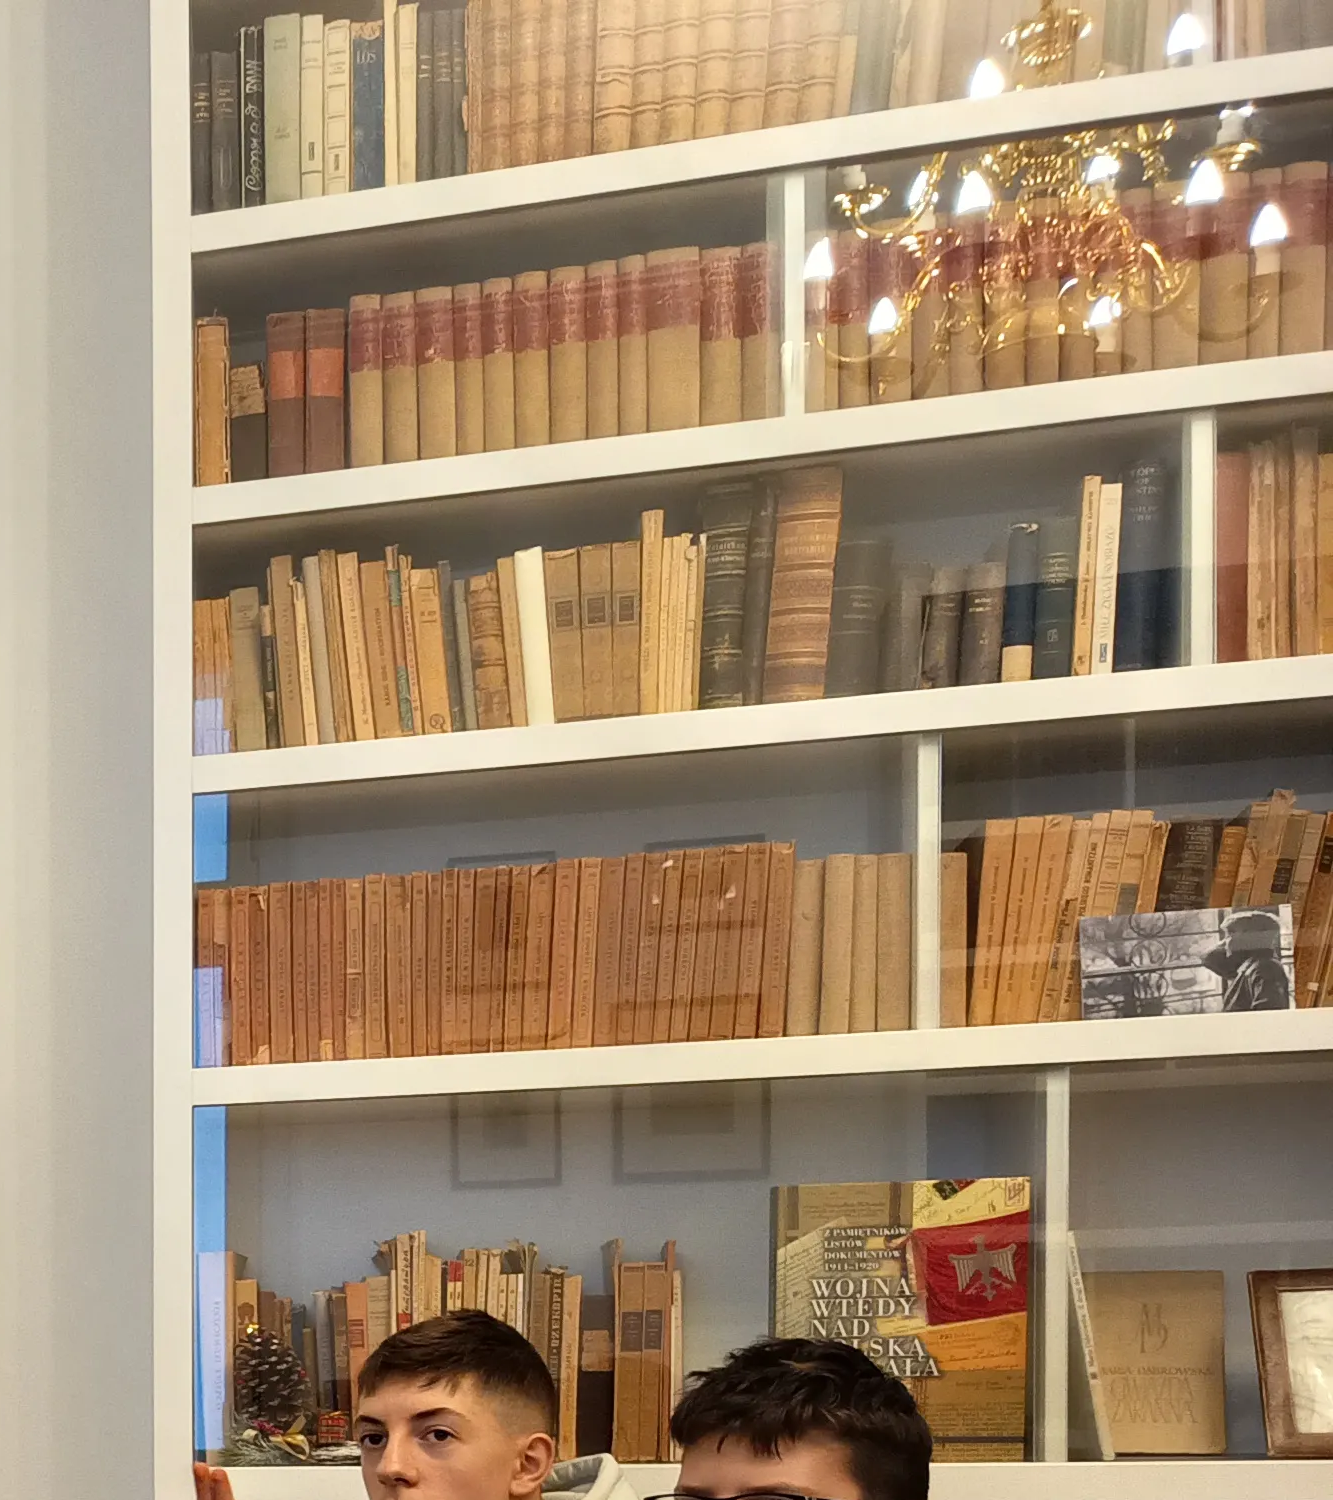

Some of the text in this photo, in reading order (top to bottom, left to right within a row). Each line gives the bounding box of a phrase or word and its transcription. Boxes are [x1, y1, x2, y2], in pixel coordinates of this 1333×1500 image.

[824, 1238, 863, 1249] LISTÓW
[824, 1248, 902, 1260] DOKUMENTÓW
[810, 1277, 914, 1298] WOJNA
[810, 1298, 916, 1318] WTEDY
[811, 1318, 870, 1338] NAD
[813, 1337, 927, 1362] LSKĄ
